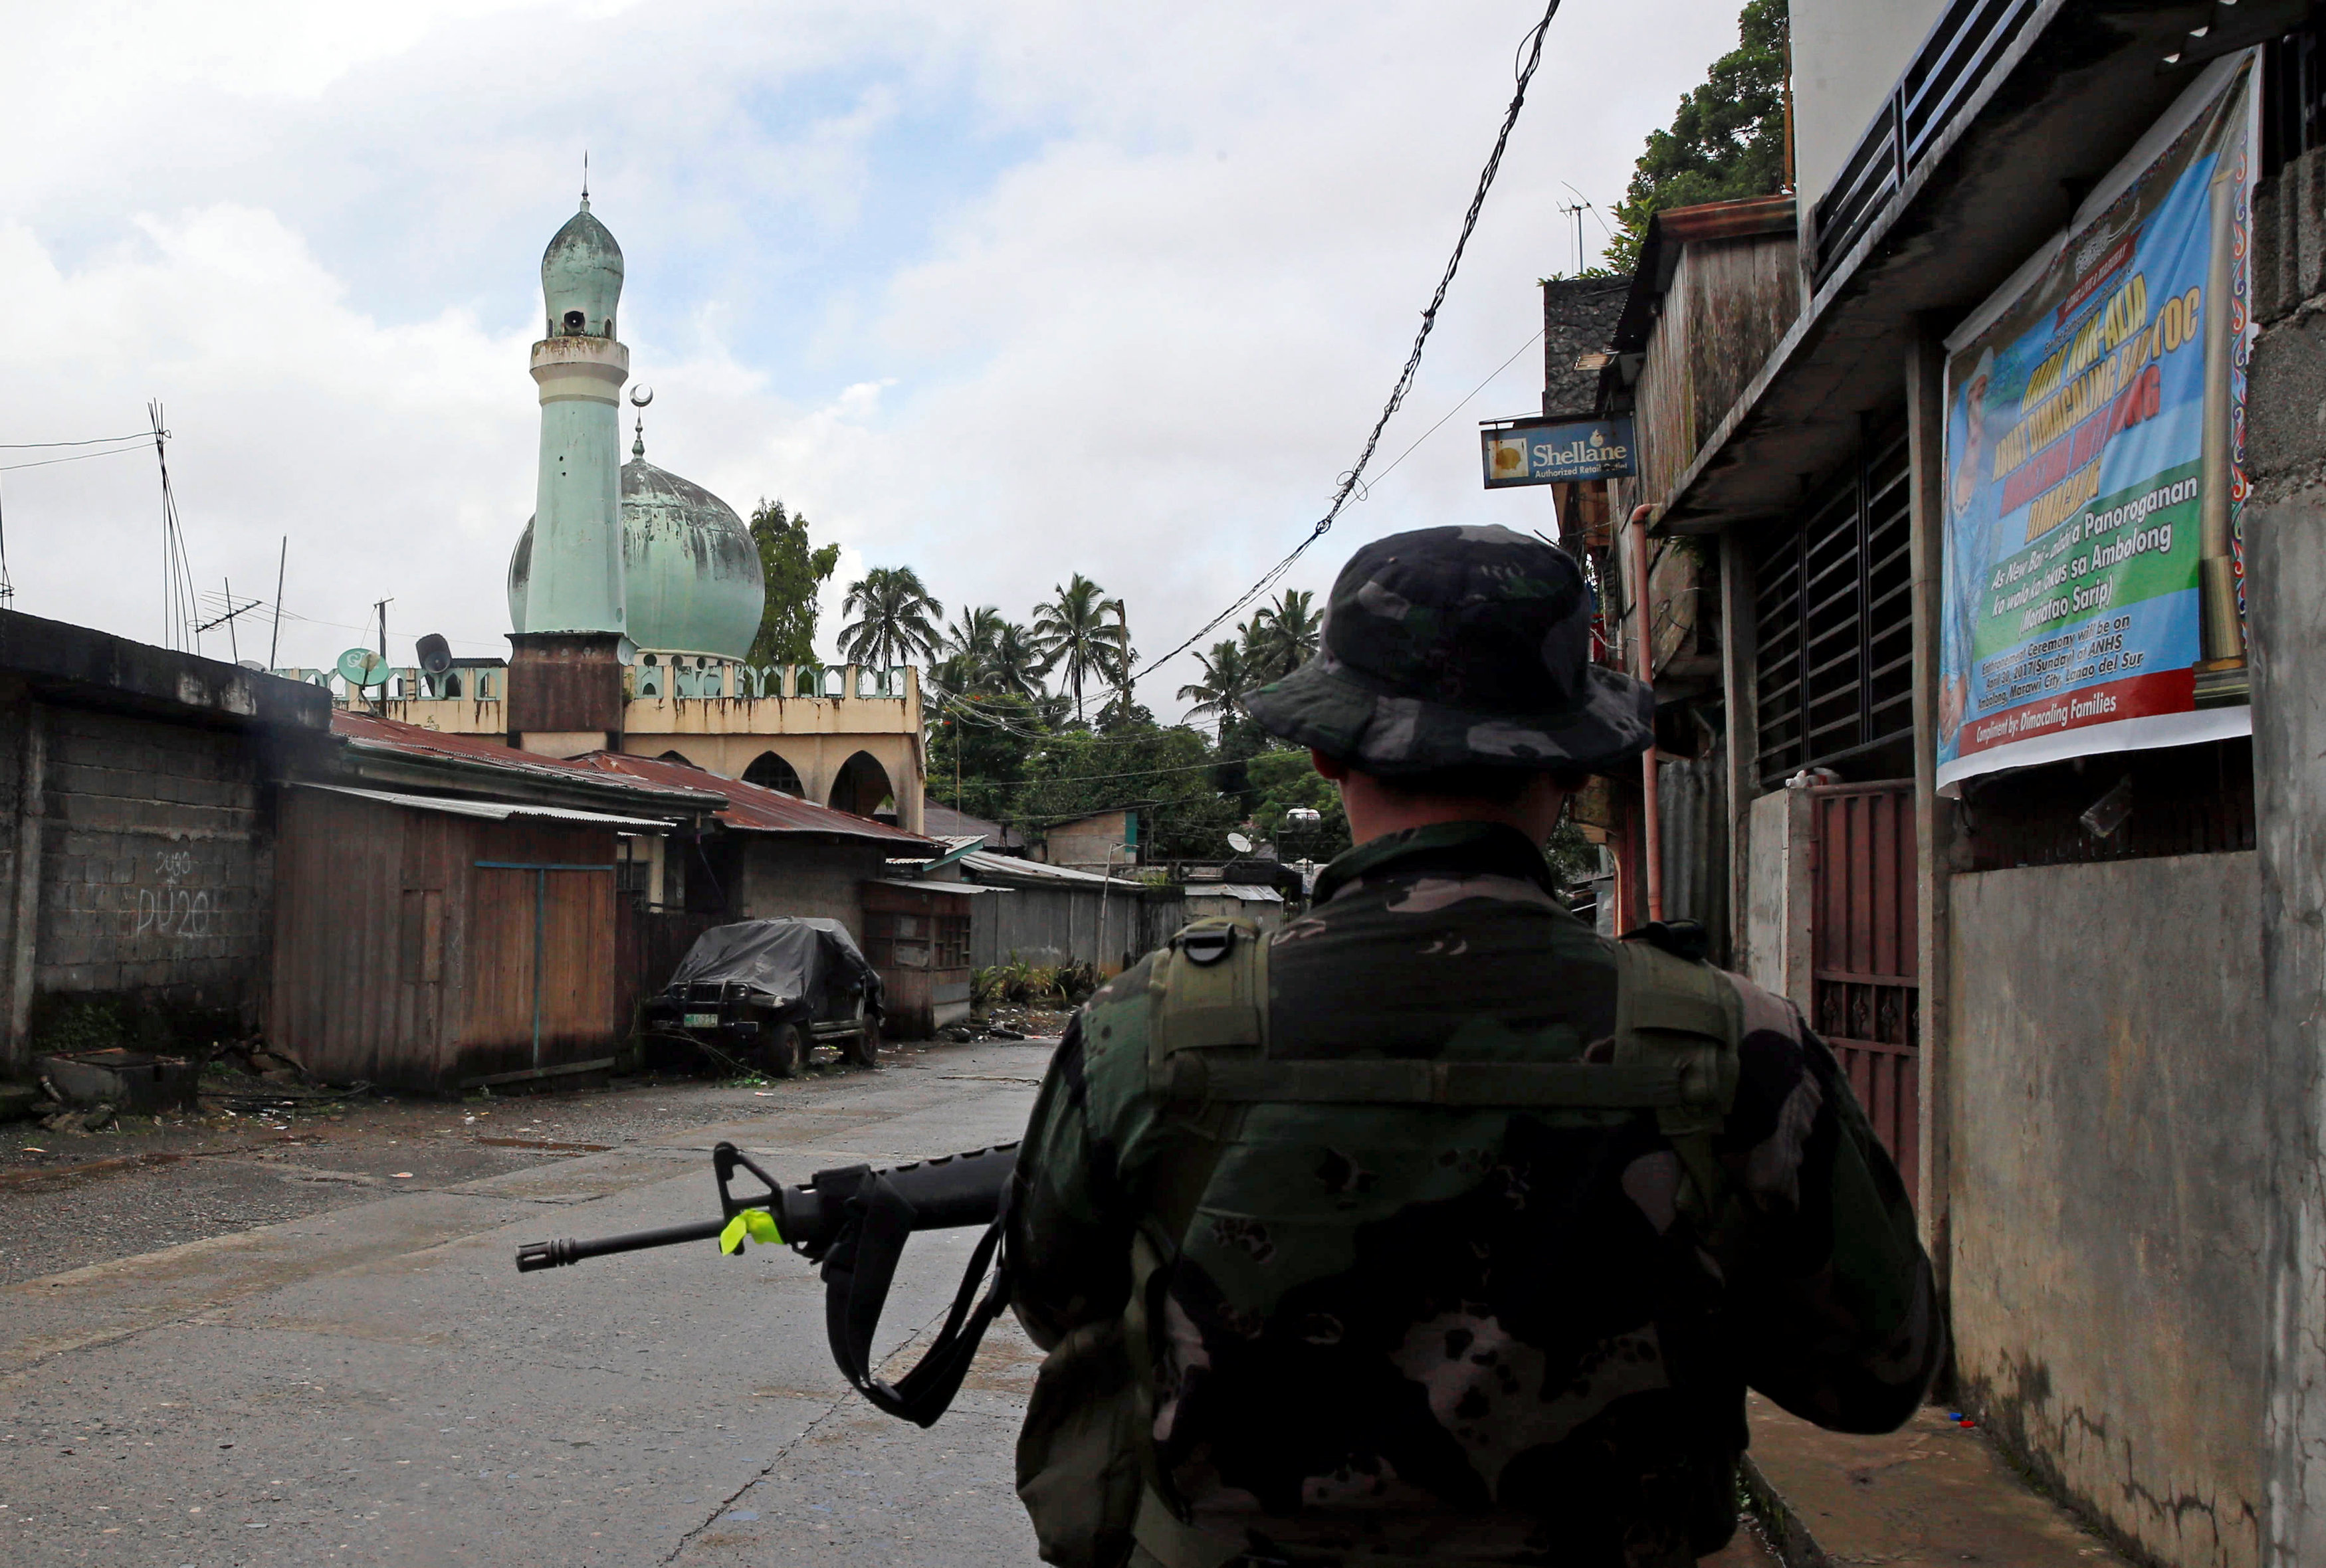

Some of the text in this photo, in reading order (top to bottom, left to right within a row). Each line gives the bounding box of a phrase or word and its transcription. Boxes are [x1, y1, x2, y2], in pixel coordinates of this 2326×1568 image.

[2028, 354, 2117, 456] DIMACALING
[1533, 441, 1628, 466] Shellane
[1535, 466, 1578, 478] Authorized
[1580, 464, 1601, 474] Retail
[1991, 569, 2005, 591] As
[2006, 561, 2028, 584] New
[2085, 476, 2198, 539] Panoroganan
[2071, 555, 2087, 578] sa
[2091, 523, 2172, 571] Ambolong
[2072, 572, 2113, 613] Sarip)
[2028, 632, 2076, 659] Ceremony
[2077, 623, 2097, 641] will
[2097, 620, 2110, 637] be
[2113, 615, 2130, 630] on
[2087, 634, 2123, 657] ANHS
[2010, 677, 2042, 700] Marawi
[2065, 664, 2095, 685] Lanao
[2099, 658, 2118, 674] del
[2121, 651, 2144, 670] Sur
[2020, 703, 2068, 732] Dimacaling
[2070, 692, 2117, 720] Families
